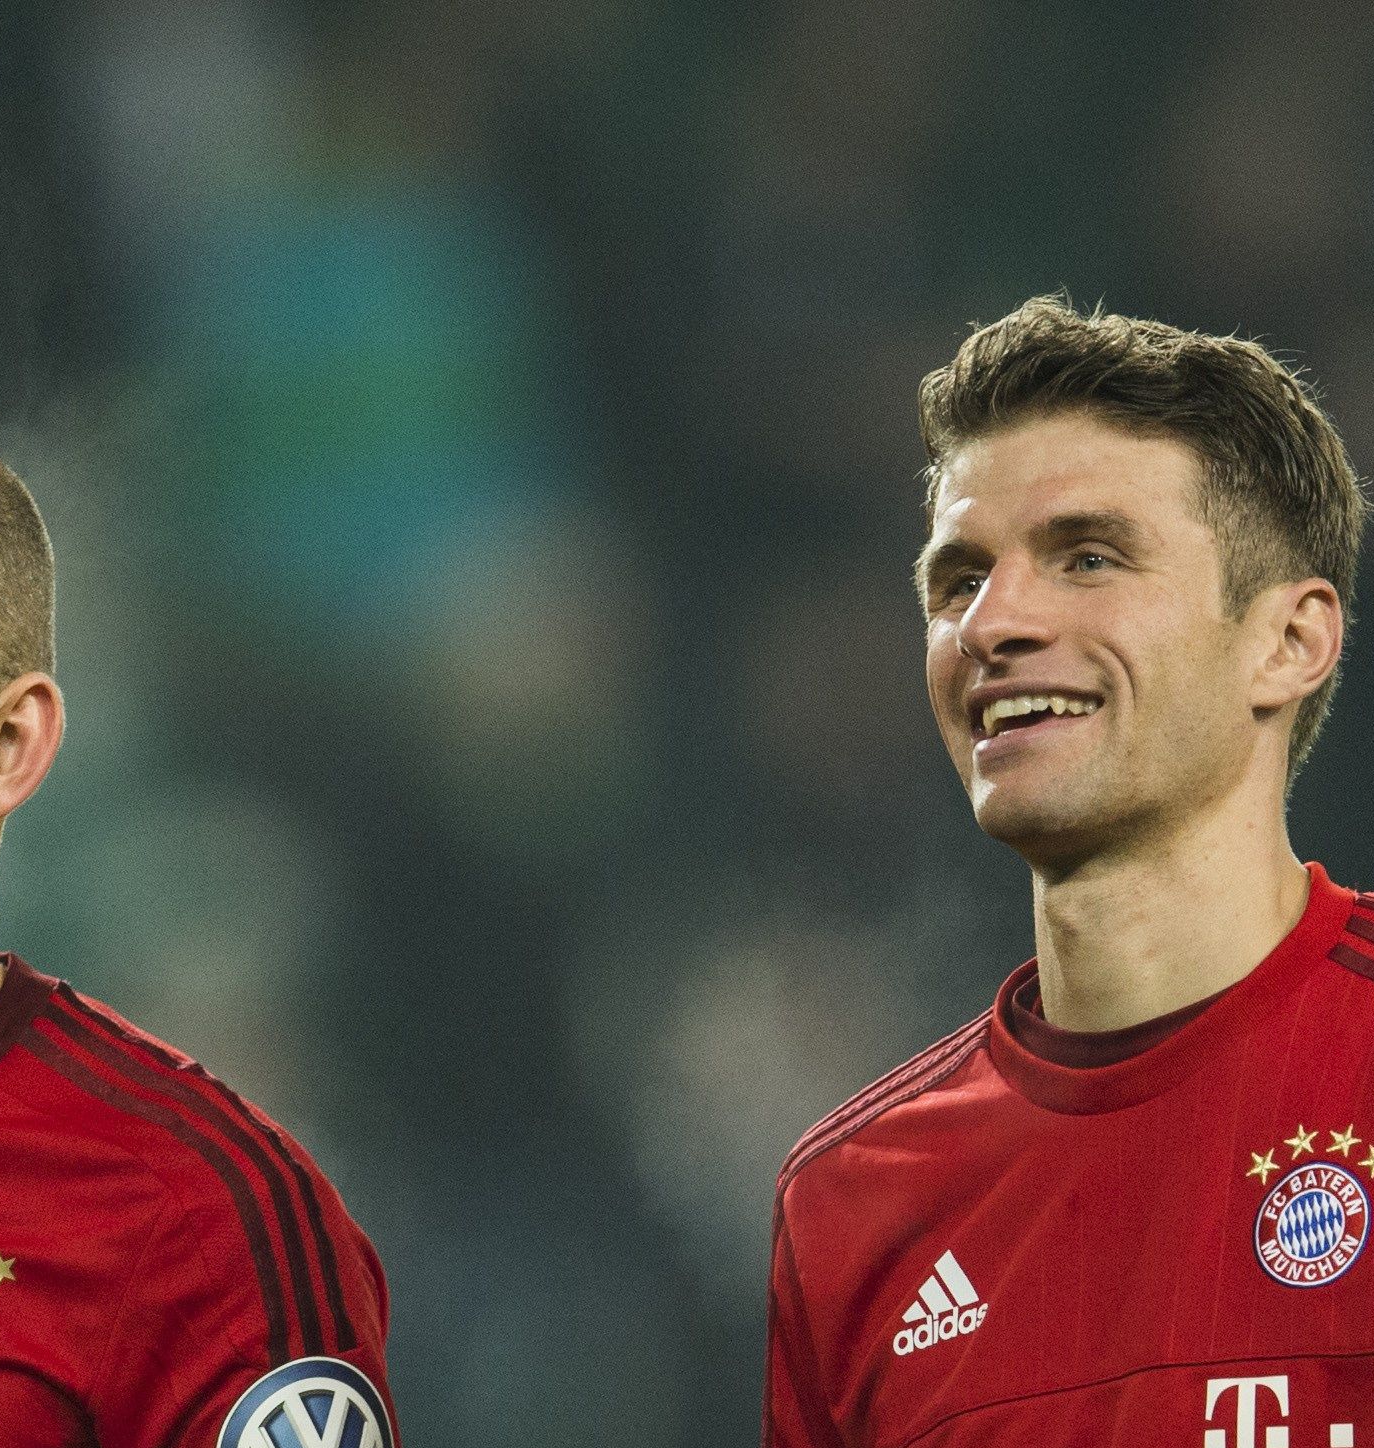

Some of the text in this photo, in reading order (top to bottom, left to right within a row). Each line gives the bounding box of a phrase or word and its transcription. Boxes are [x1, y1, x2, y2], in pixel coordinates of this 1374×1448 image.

[1264, 1169, 1363, 1221] FC BAYERN
[892, 1300, 989, 1357] adidas
